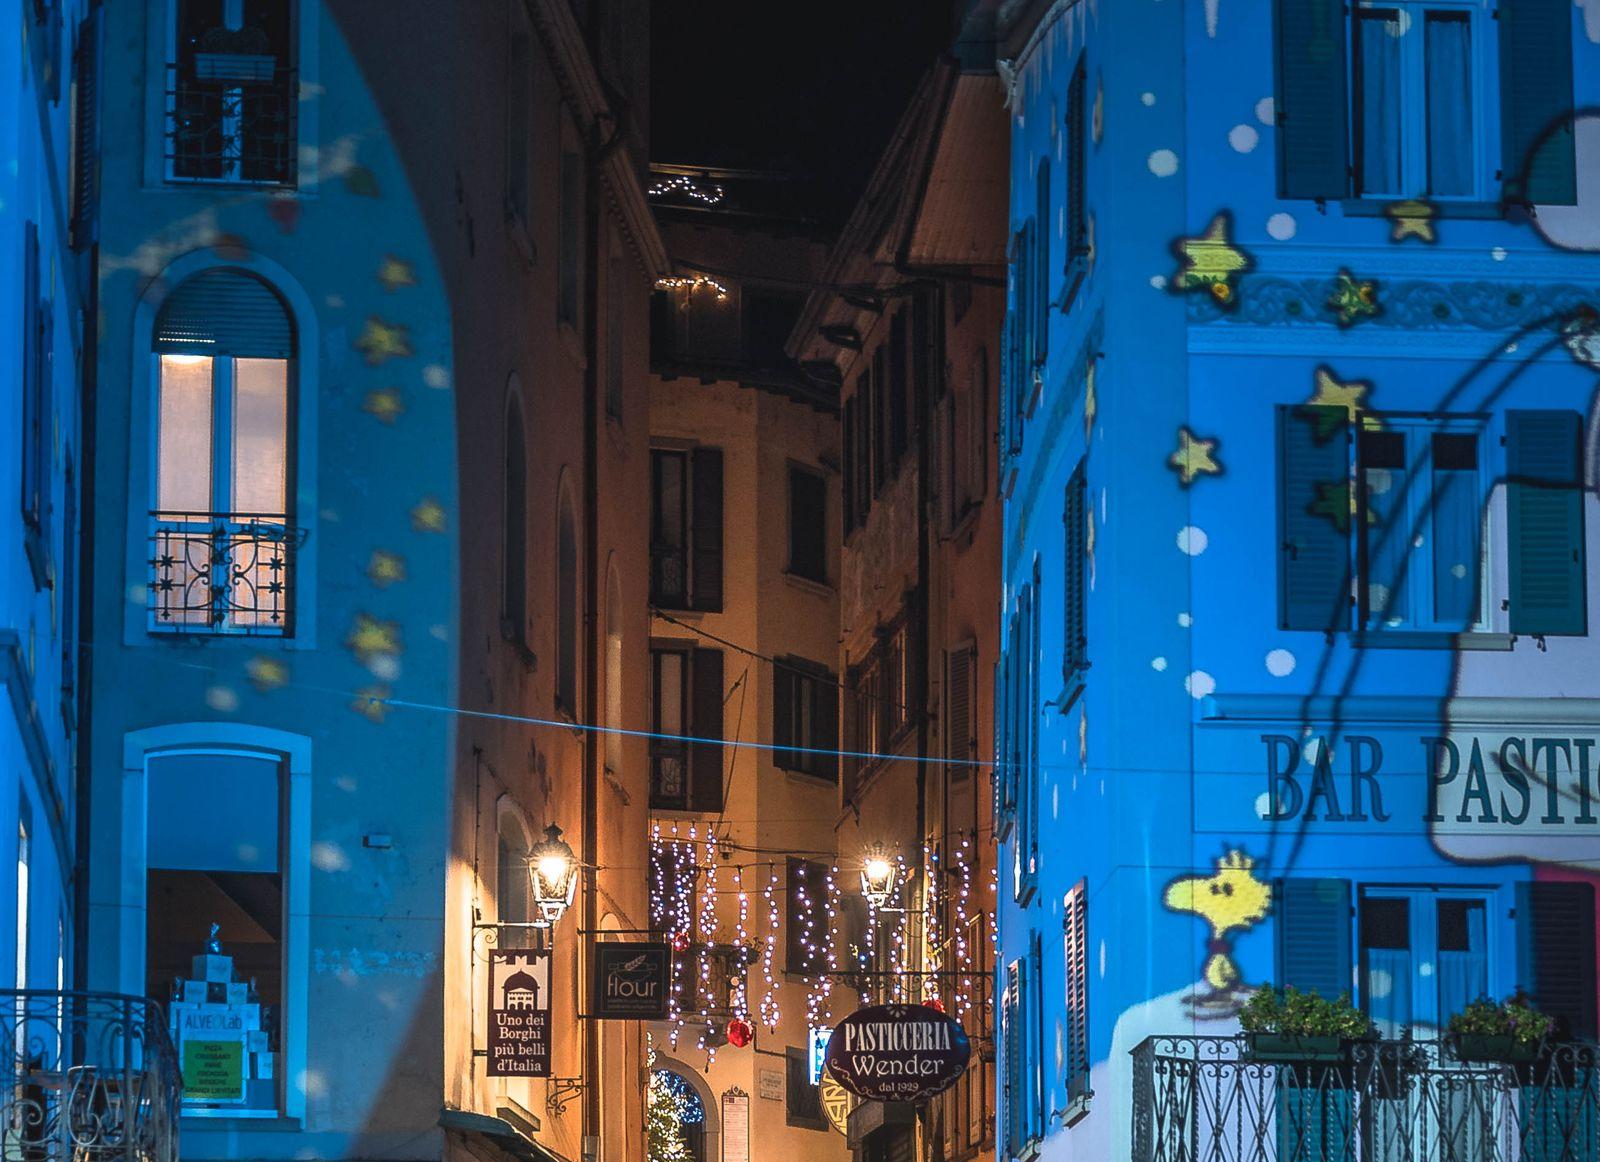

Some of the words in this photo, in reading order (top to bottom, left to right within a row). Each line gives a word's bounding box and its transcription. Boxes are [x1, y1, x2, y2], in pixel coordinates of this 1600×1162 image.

[1260, 734, 1391, 823] BAR
[1420, 735, 1600, 826] PASTI
[607, 972, 657, 997] flour
[496, 1013, 522, 1026] Uno
[526, 1013, 545, 1026] dei
[499, 1026, 541, 1042] Borghi
[845, 1021, 951, 1052] PASTICCERIA
[494, 1043, 515, 1058] più
[518, 1043, 546, 1056] belli
[497, 1059, 542, 1072] d'Italia
[852, 1054, 945, 1078] Wender
[879, 1082, 895, 1092] dal
[897, 1082, 919, 1092] 1929
